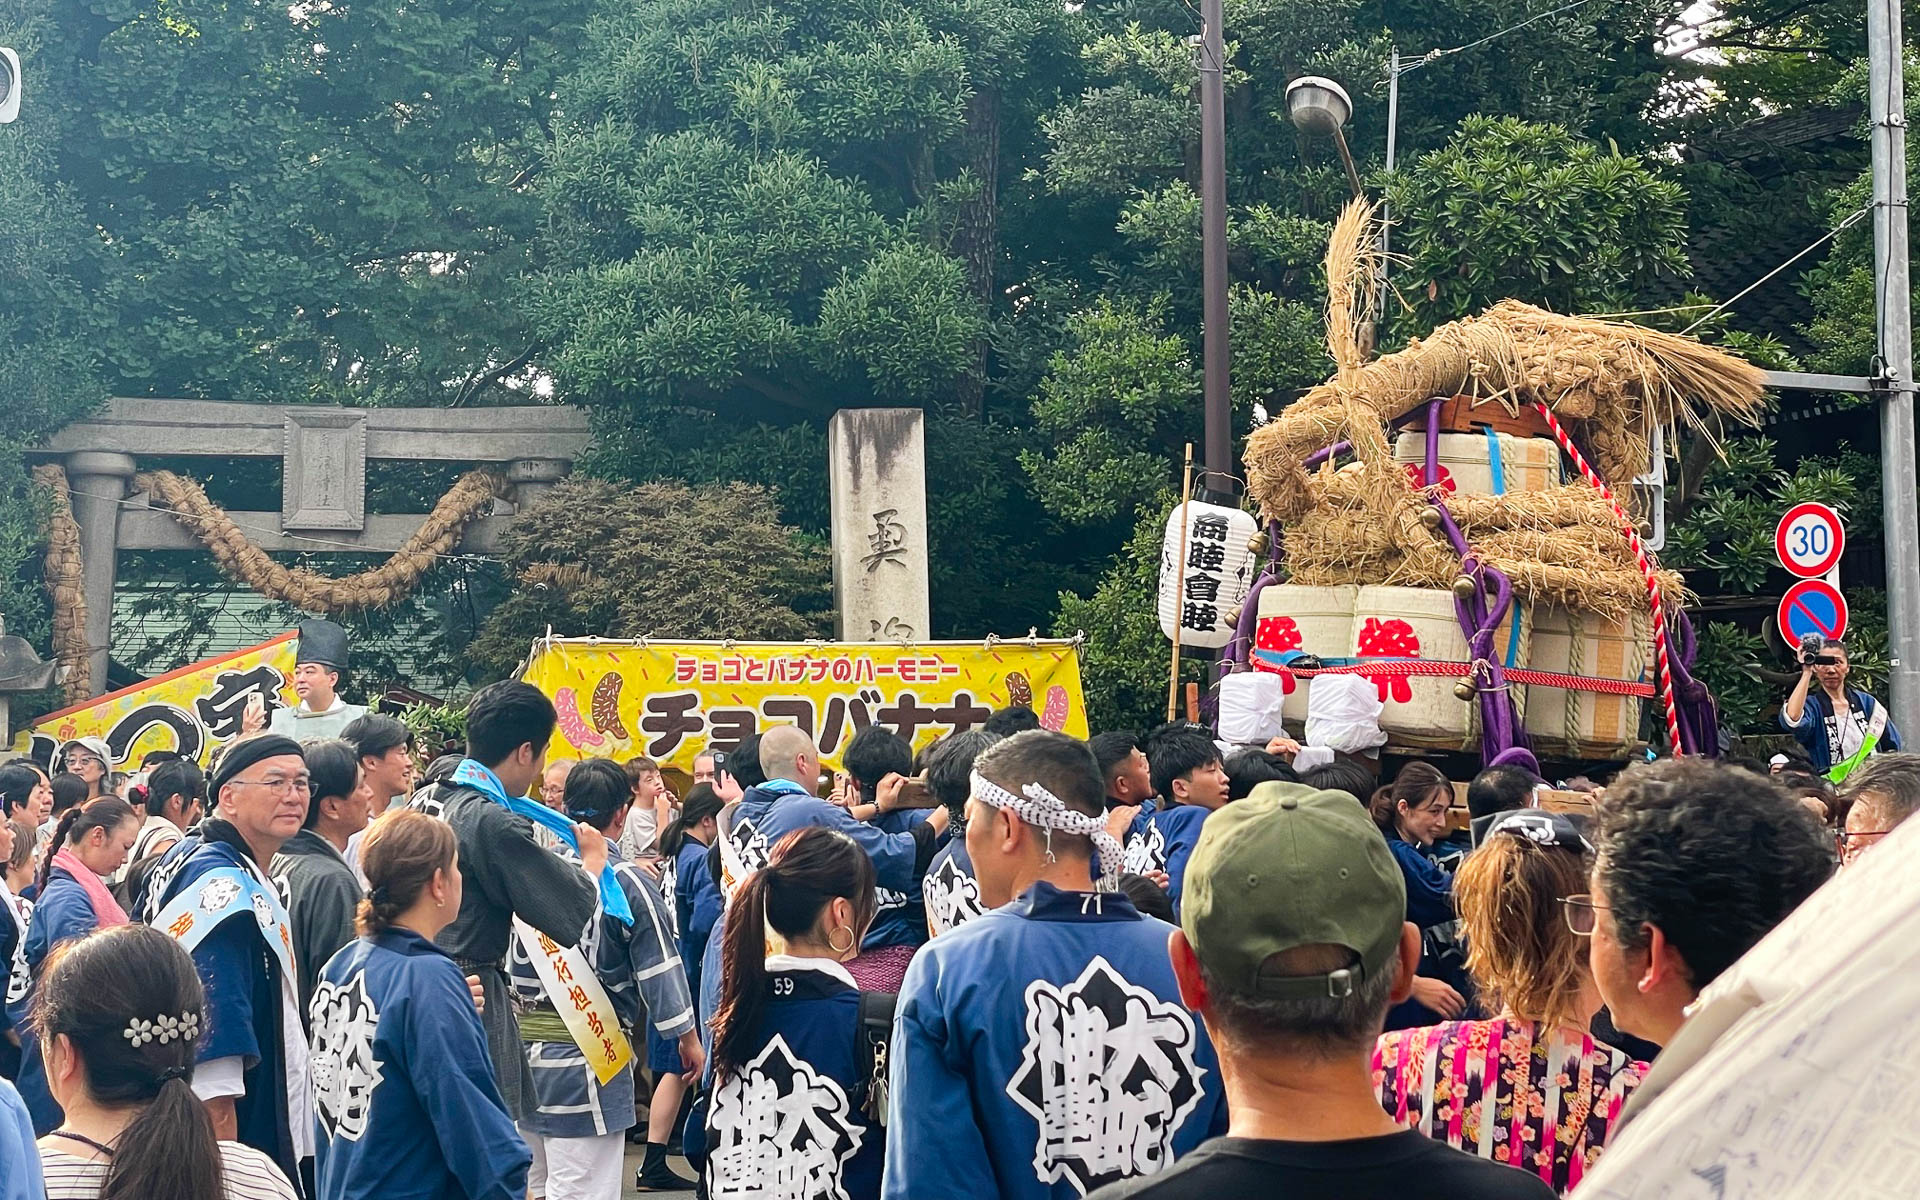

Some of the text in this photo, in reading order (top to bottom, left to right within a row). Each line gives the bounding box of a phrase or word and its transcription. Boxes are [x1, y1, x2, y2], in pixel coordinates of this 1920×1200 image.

[1792, 524, 1828, 556] 30
[677, 659, 958, 682] チョコとバナナのハーモニー
[641, 689, 991, 758] チョコバナナ
[1080, 893, 1102, 915] 71
[537, 933, 618, 1065] 巡行担当者
[774, 977, 794, 995] 59
